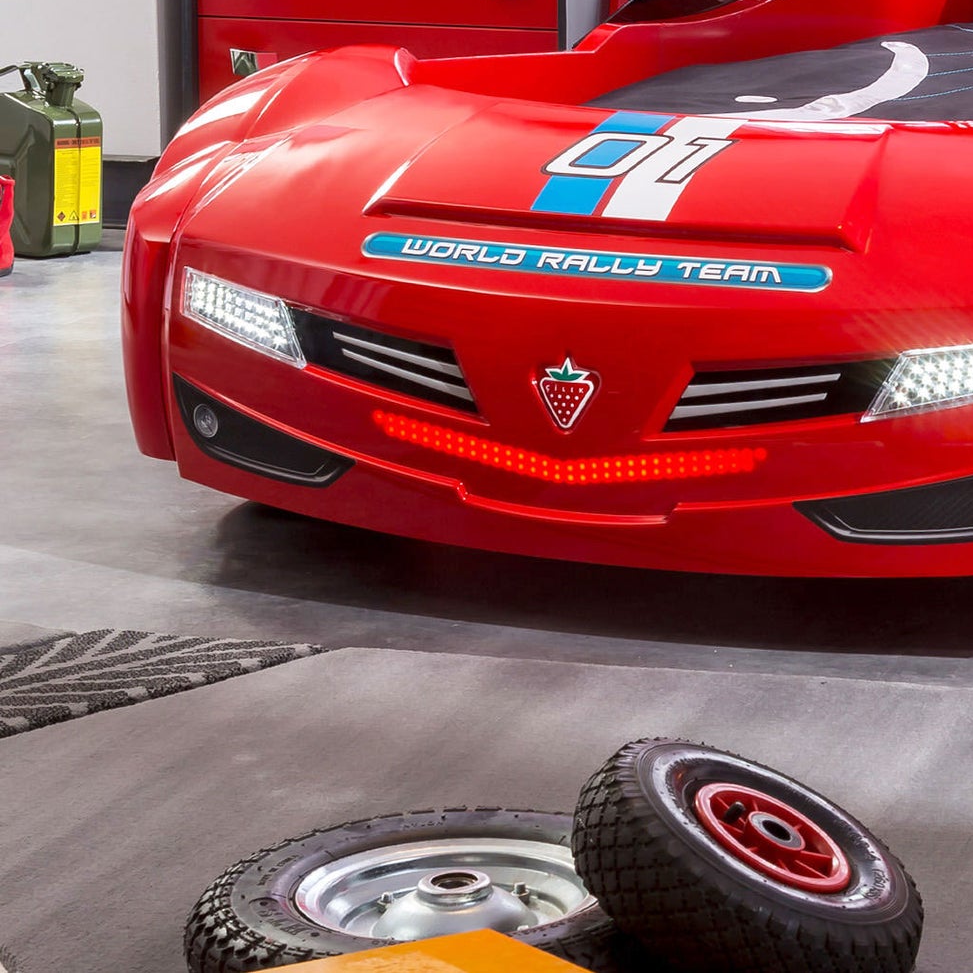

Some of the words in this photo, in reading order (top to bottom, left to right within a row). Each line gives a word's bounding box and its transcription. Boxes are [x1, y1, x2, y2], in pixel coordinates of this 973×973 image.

[539, 130, 741, 185] 01
[401, 238, 528, 266] WORLD
[536, 252, 663, 277] RALLY
[677, 261, 782, 284] TEAM
